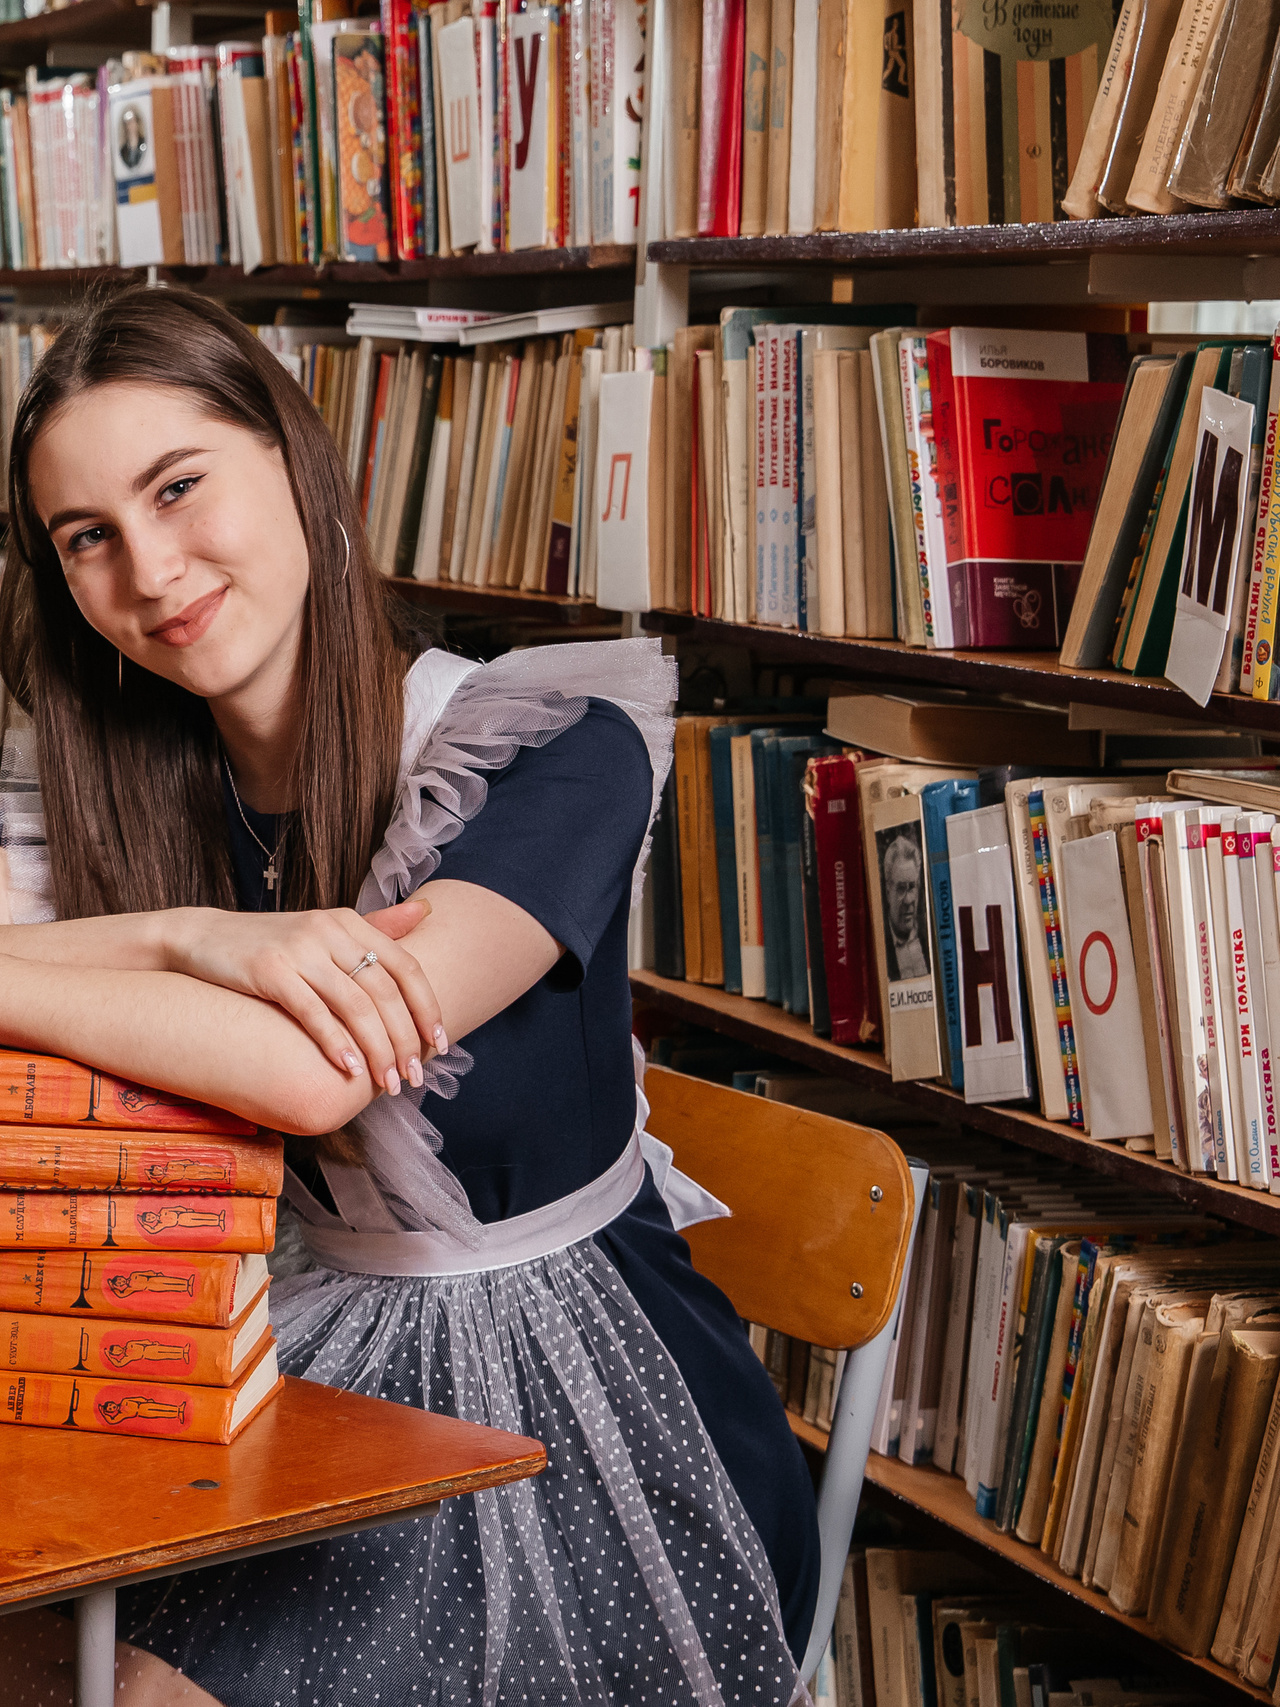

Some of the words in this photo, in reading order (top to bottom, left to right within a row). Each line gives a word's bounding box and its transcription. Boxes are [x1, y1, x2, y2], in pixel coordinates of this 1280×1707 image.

[1012, 2, 1080, 27] детские
[979, 345, 1007, 356] ИЛЬЯ
[980, 357, 1045, 371] БОРОВИКОВ
[602, 453, 632, 522] Л
[1259, 411, 1278, 519] ЧЕЛОВЕКОМ!
[1254, 526, 1266, 572] БУДЬ
[1022, 828, 1032, 875] НЕКРАСОВ
[1037, 823, 1050, 874] Врунгеля
[834, 860, 846, 949] МАКАРЕНКО
[1043, 876, 1056, 928] капитана
[958, 904, 1015, 1048] Н
[1049, 929, 1066, 1007] Приключения
[1080, 931, 1119, 1016] О
[1198, 920, 1212, 1006] ТОЛСТЯКА
[1232, 928, 1249, 1015] ТОЛСТЯКА
[1061, 1023, 1074, 1076] Некрасов
[1206, 1015, 1216, 1049] ТРИ
[1240, 1023, 1252, 1058] ТРИ
[1068, 1077, 1080, 1120] Андрей
[1260, 1047, 1277, 1136] ТОЛСТЯКА
[1215, 1109, 1225, 1146] Олеша
[1249, 1119, 1259, 1156] Олеша
[1250, 1157, 1261, 1173] Ю.
[15, 1194, 26, 1242] М.СЛУЦКИ
[996, 1301, 1008, 1356] КЛАДОВАЯ
